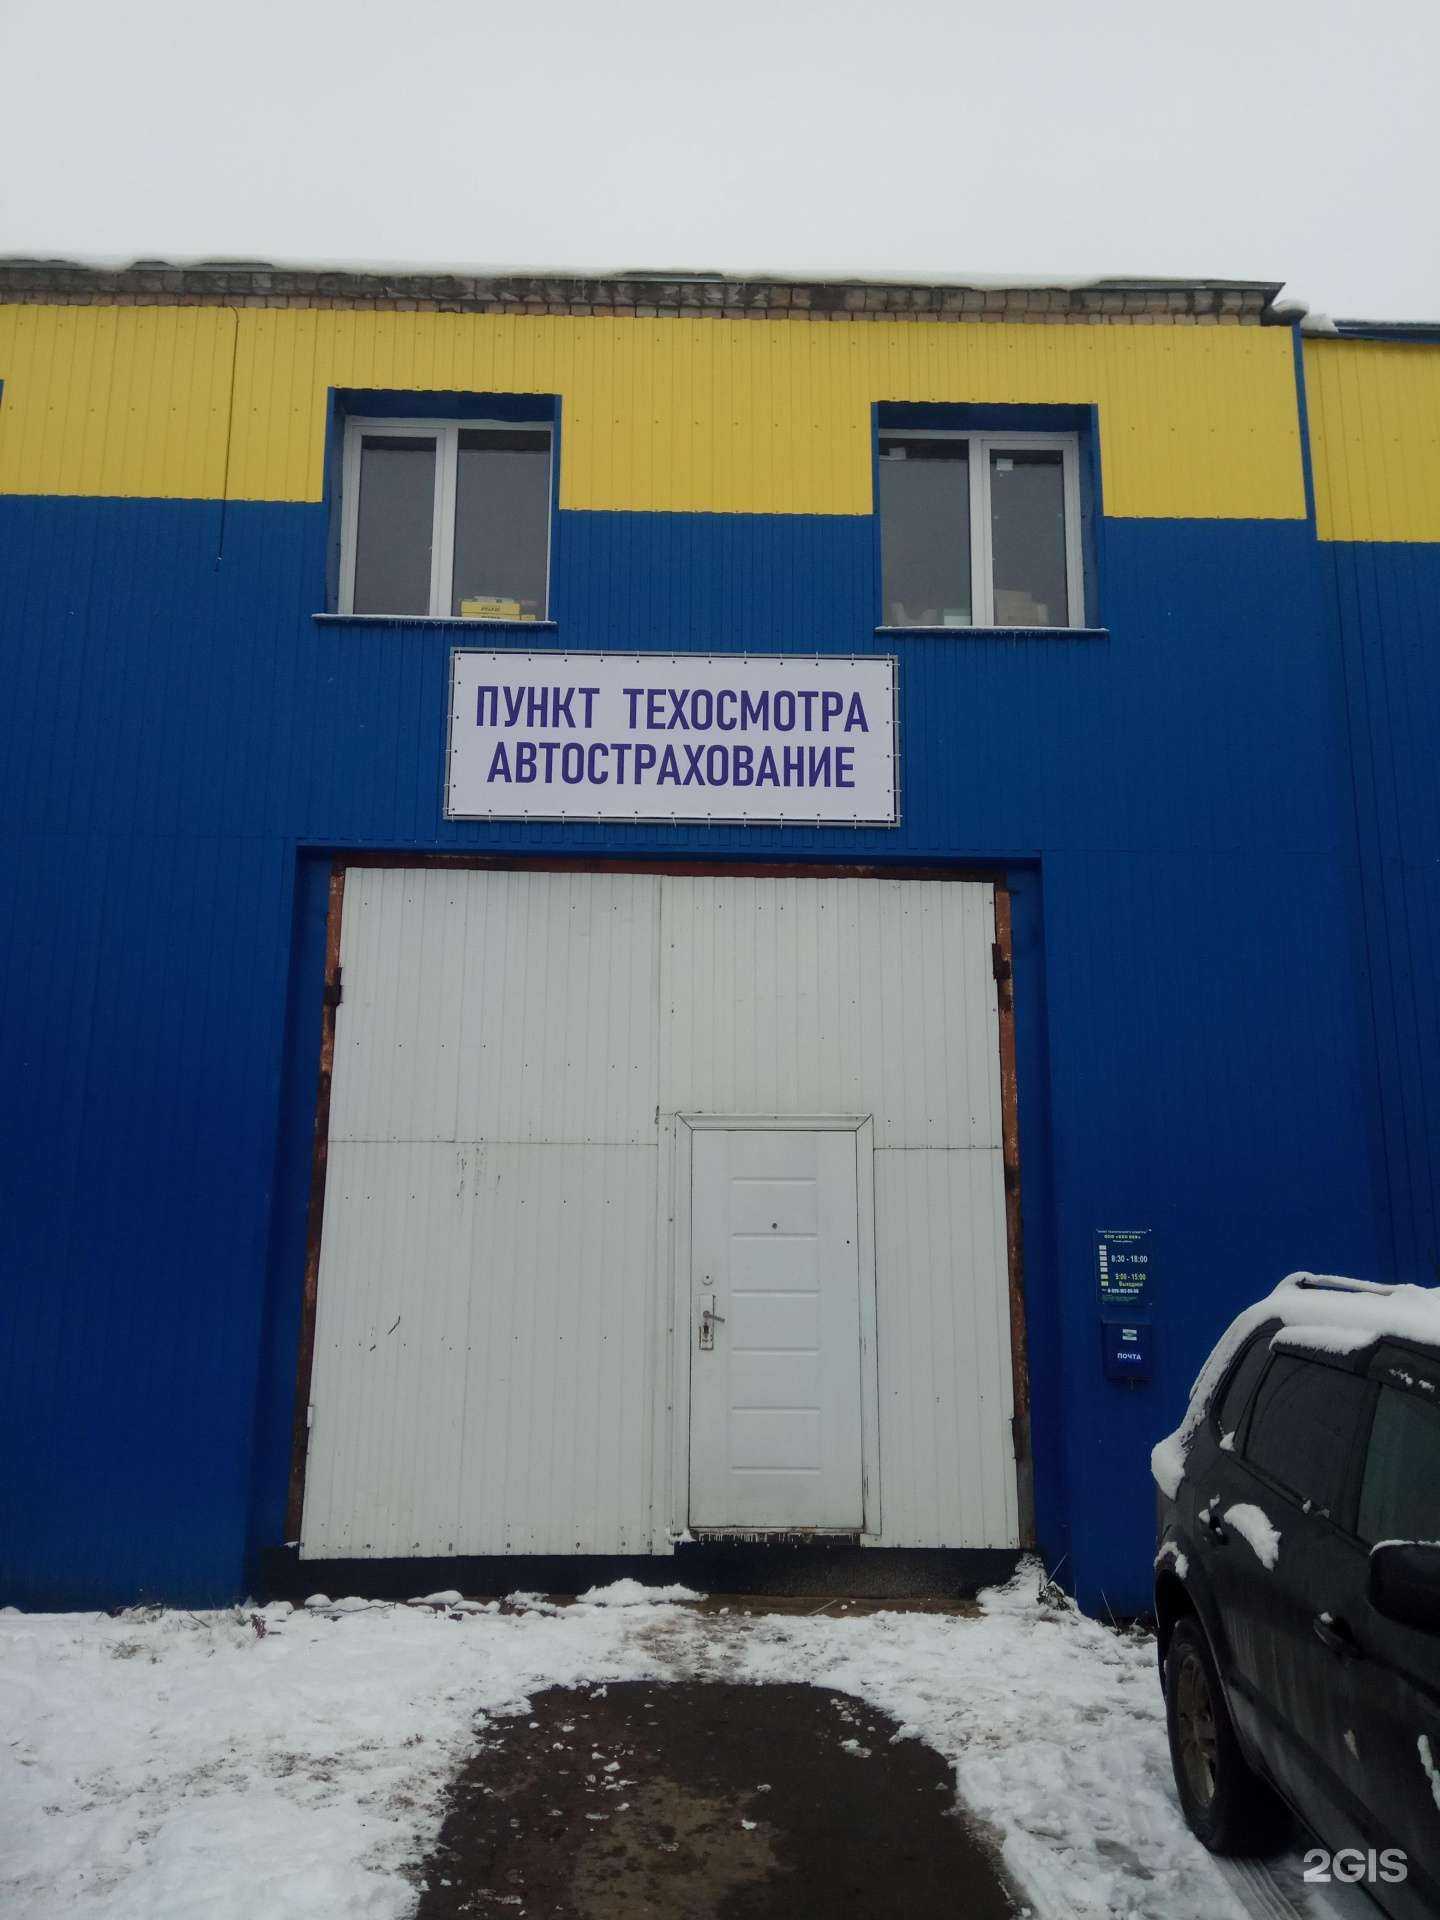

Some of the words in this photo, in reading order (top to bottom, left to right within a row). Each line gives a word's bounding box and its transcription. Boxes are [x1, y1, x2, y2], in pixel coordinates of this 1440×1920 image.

[476, 685, 600, 728] ПУНКТ
[622, 688, 869, 733] ТЕХОСМОТРА
[486, 741, 856, 788] АВТОСТРАХОВАНИЕ
[1130, 1255, 1148, 1263] 18:00
[1117, 1352, 1142, 1361] ПОЧТА
